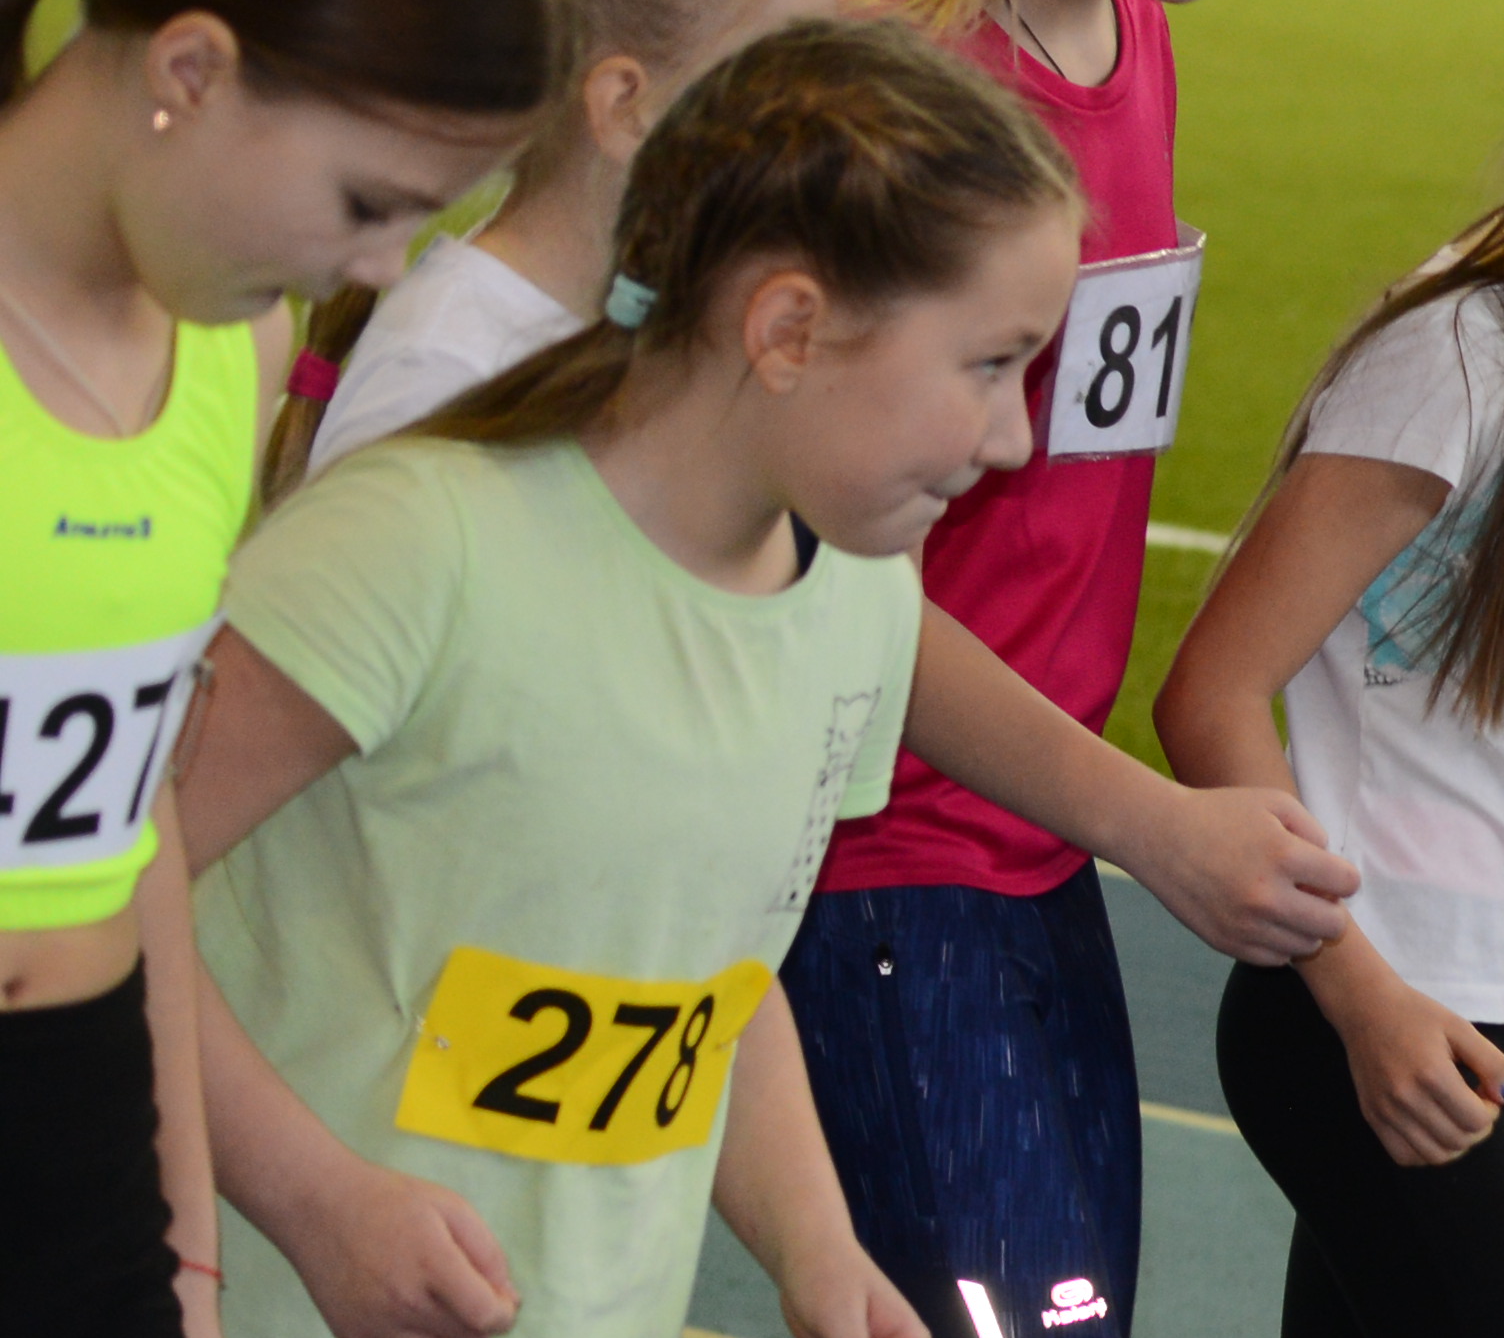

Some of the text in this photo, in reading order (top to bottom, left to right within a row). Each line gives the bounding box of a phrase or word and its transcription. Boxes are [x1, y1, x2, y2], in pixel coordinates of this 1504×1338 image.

[1083, 294, 1184, 428] 81
[0, 669, 178, 845] 27
[472, 987, 716, 1132] 278
